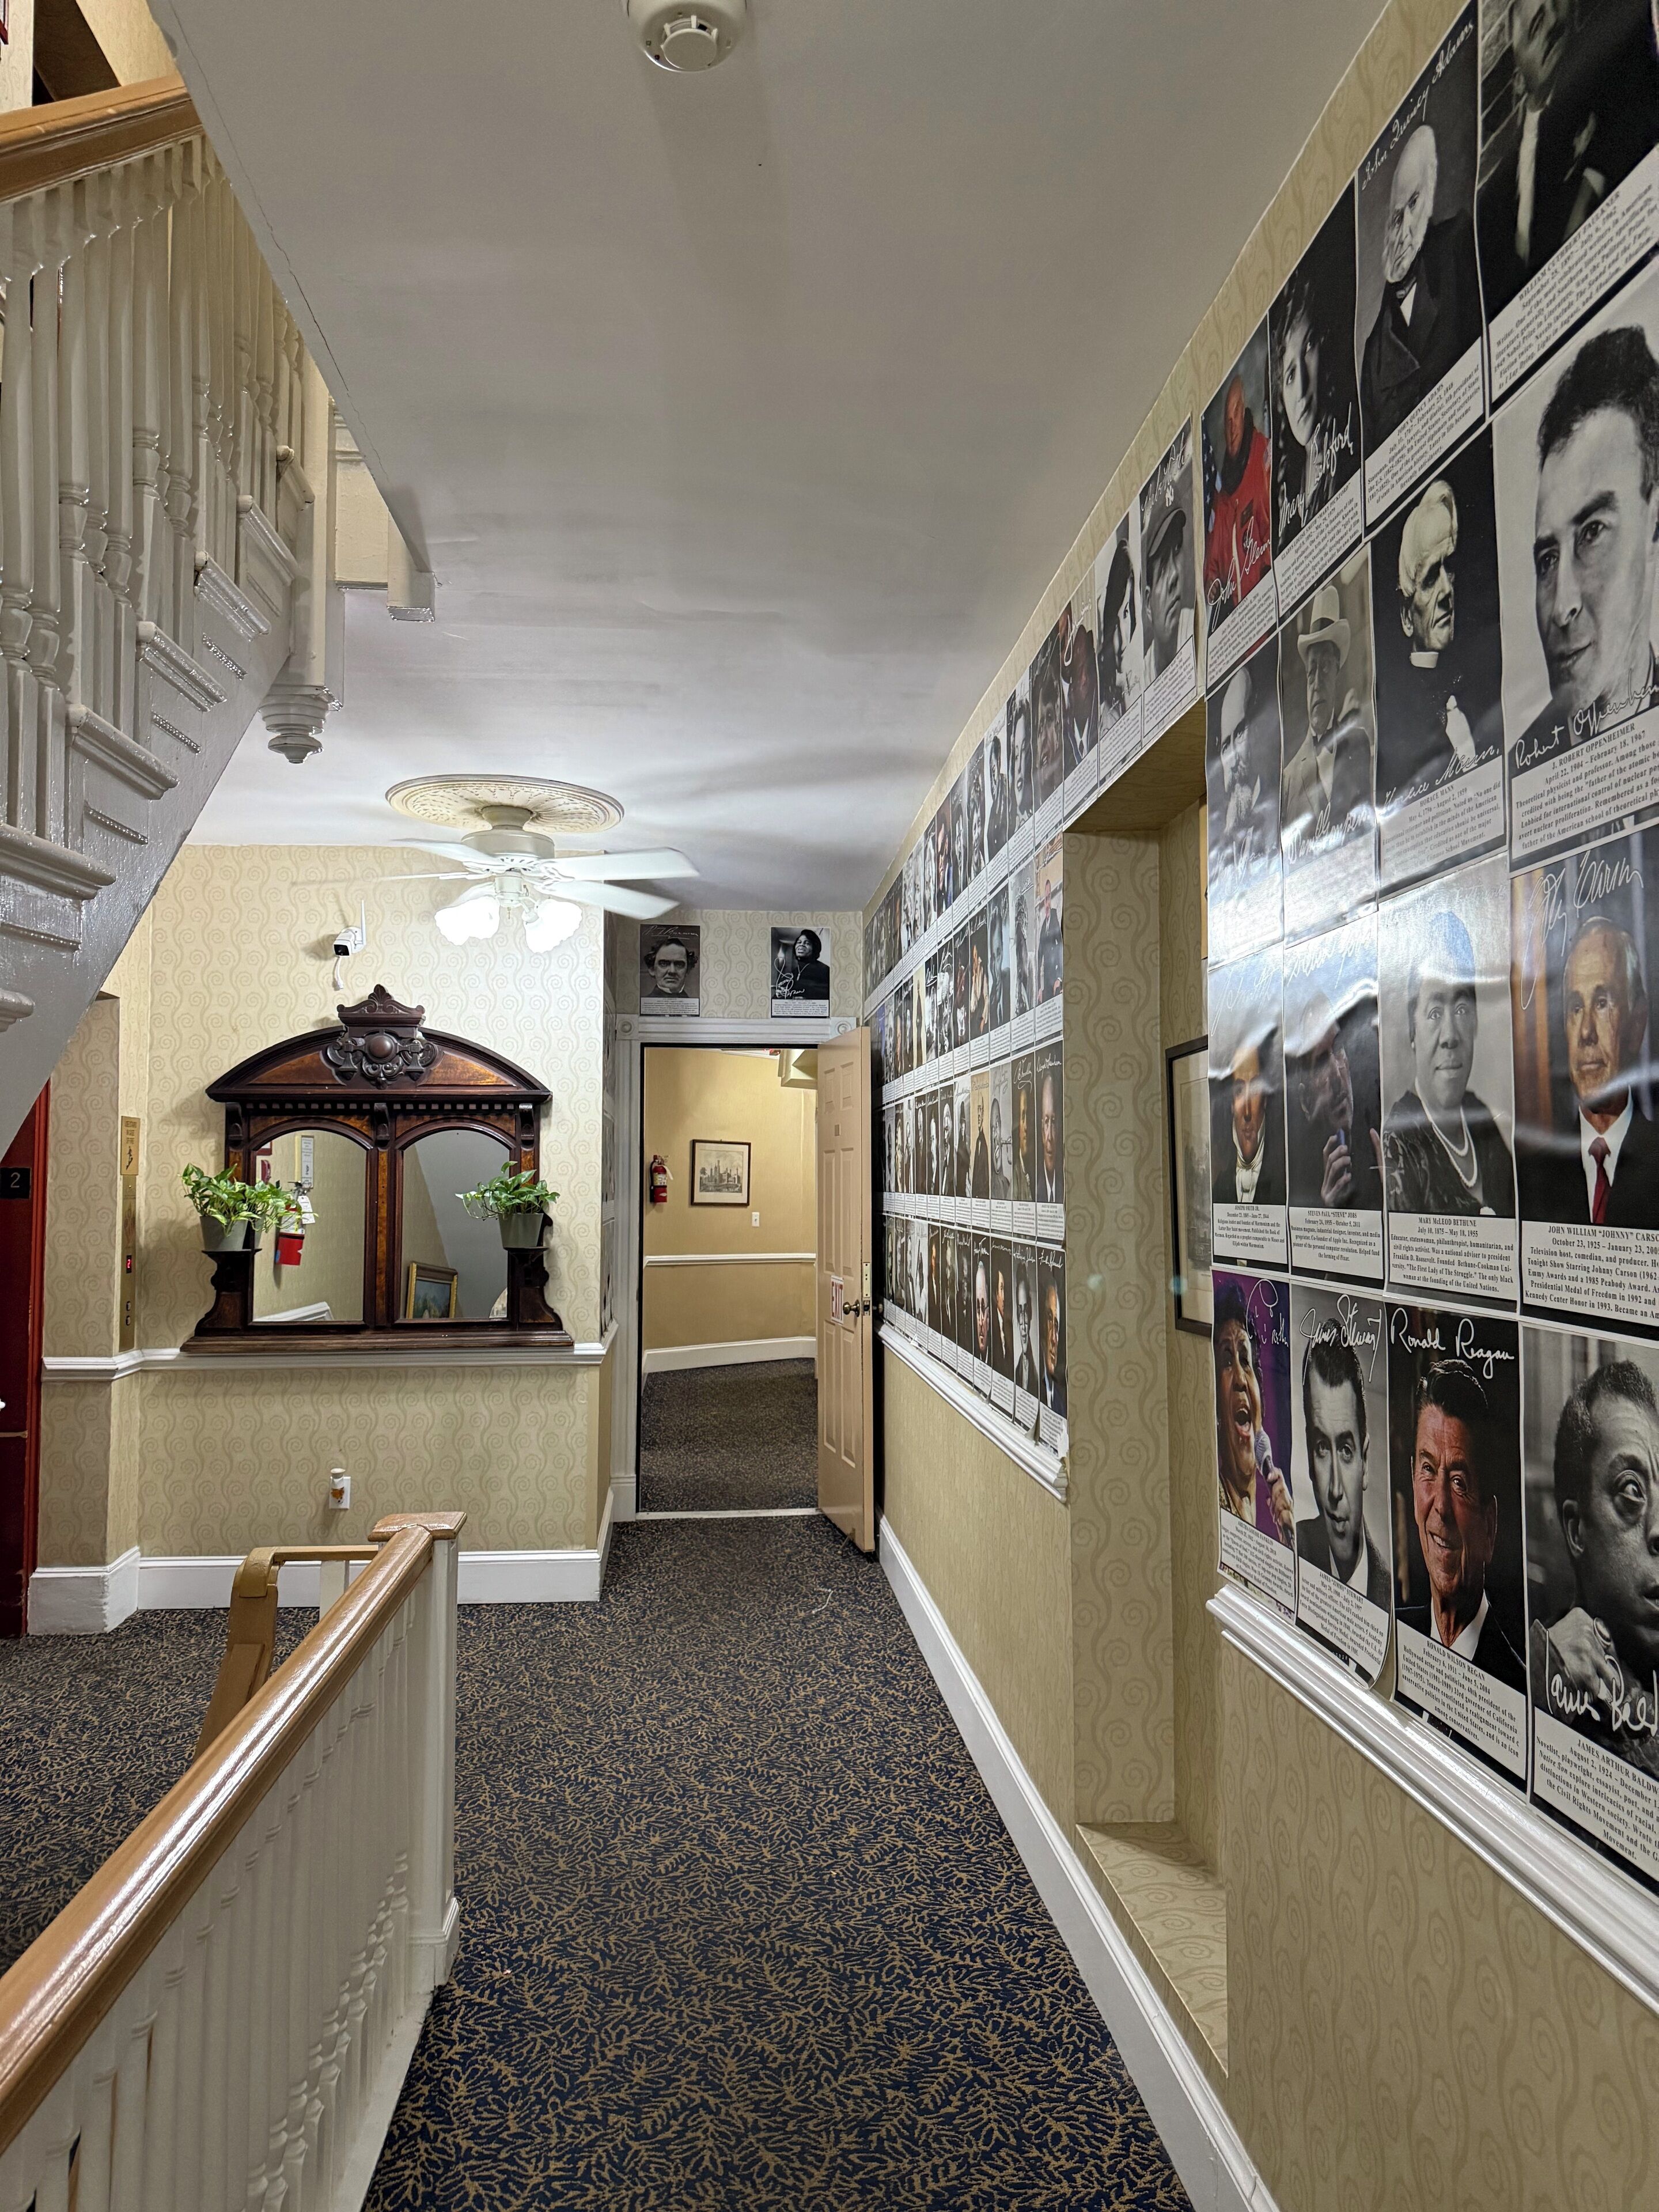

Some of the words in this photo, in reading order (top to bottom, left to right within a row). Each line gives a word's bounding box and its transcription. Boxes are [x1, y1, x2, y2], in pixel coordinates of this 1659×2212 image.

[1544, 771, 1559, 785] April
[1570, 760, 1583, 773] 1904
[1589, 745, 1617, 763] February
[1630, 729, 1645, 744] 1967
[1551, 761, 1557, 770] J.
[1558, 747, 1584, 767] ROBERT
[1585, 722, 1635, 753] OPPENHEIMER
[1516, 789, 1545, 809] Theoretical
[1546, 778, 1571, 797] physicist
[1571, 771, 1583, 783] and
[1584, 760, 1613, 780] professor.
[1614, 748, 1637, 764] Among
[1638, 740, 1656, 753] those
[1521, 801, 1543, 817] credited
[1544, 796, 1556, 806] with
[1557, 789, 1573, 801] being
[1574, 785, 1584, 794] the
[1608, 768, 1615, 779] of
[1616, 766, 1627, 775] the
[1628, 755, 1650, 770] atomic
[10, 1172, 21, 1188] 2
[1417, 1226, 1426, 1234] July
[1434, 1227, 1444, 1235] 1875
[1448, 1228, 1458, 1237] May
[1467, 1229, 1478, 1237] 1955
[1418, 1216, 1431, 1224] MARY
[1432, 1217, 1452, 1225] McLEOD
[1452, 1218, 1476, 1227] BETHUNE
[1548, 1225, 1565, 1234] JOHN
[1566, 1226, 1597, 1237] WILLIAM
[1530, 1246, 1557, 1256] Television
[1605, 1255, 1616, 1263] and
[1618, 1256, 1649, 1267] producer.
[1551, 1237, 1575, 1247] October
[1587, 1240, 1600, 1249] 1925
[1607, 1241, 1632, 1252] January
[127, 1259, 131, 1268] 2
[1527, 1257, 1548, 1268] Tonight
[1549, 1259, 1564, 1268] Show
[1566, 1261, 1590, 1274] Starring
[1591, 1264, 1613, 1275] Johnny
[1615, 1267, 1637, 1278] Carson
[1528, 1268, 1544, 1279] Emmy
[1546, 1271, 1566, 1281] Awards
[1567, 1274, 1578, 1282] and
[1585, 1275, 1599, 1285] 1985
[1600, 1277, 1626, 1290] Peabody
[1627, 1282, 1650, 1292] Award.
[1530, 1279, 1563, 1291] Presidential
[1564, 1284, 1582, 1294] Medal
[1583, 1287, 1590, 1296] of
[1591, 1288, 1617, 1300] Freedom
[1619, 1292, 1625, 1301] in
[1627, 1293, 1642, 1304] 1992
[1643, 1297, 1656, 1306] and
[1525, 1289, 1547, 1302] Kennedy
[1549, 1293, 1568, 1304] Center
[1569, 1296, 1588, 1307] Honor
[1588, 1300, 1595, 1308] in
[1597, 1301, 1613, 1311] 1993.
[1614, 1304, 1638, 1316] Became
[1391, 1308, 1446, 1354] Ronald
[1455, 1318, 1515, 1380] Reagan
[1577, 1738, 1600, 1759] JAMES
[1600, 1753, 1630, 1778] ARTHUR
[1569, 1746, 1589, 1764] August
[1599, 1764, 1612, 1779] 1924
[1619, 1777, 1652, 1804] December
[1546, 1778, 1555, 1790] the
[1556, 1785, 1571, 1801] Civil
[1572, 1795, 1591, 1815] Rights
[1593, 1809, 1624, 1838] Movement
[1626, 1834, 1638, 1847] and
[1639, 1843, 1650, 1856] the
[1641, 1806, 1654, 1819] and
